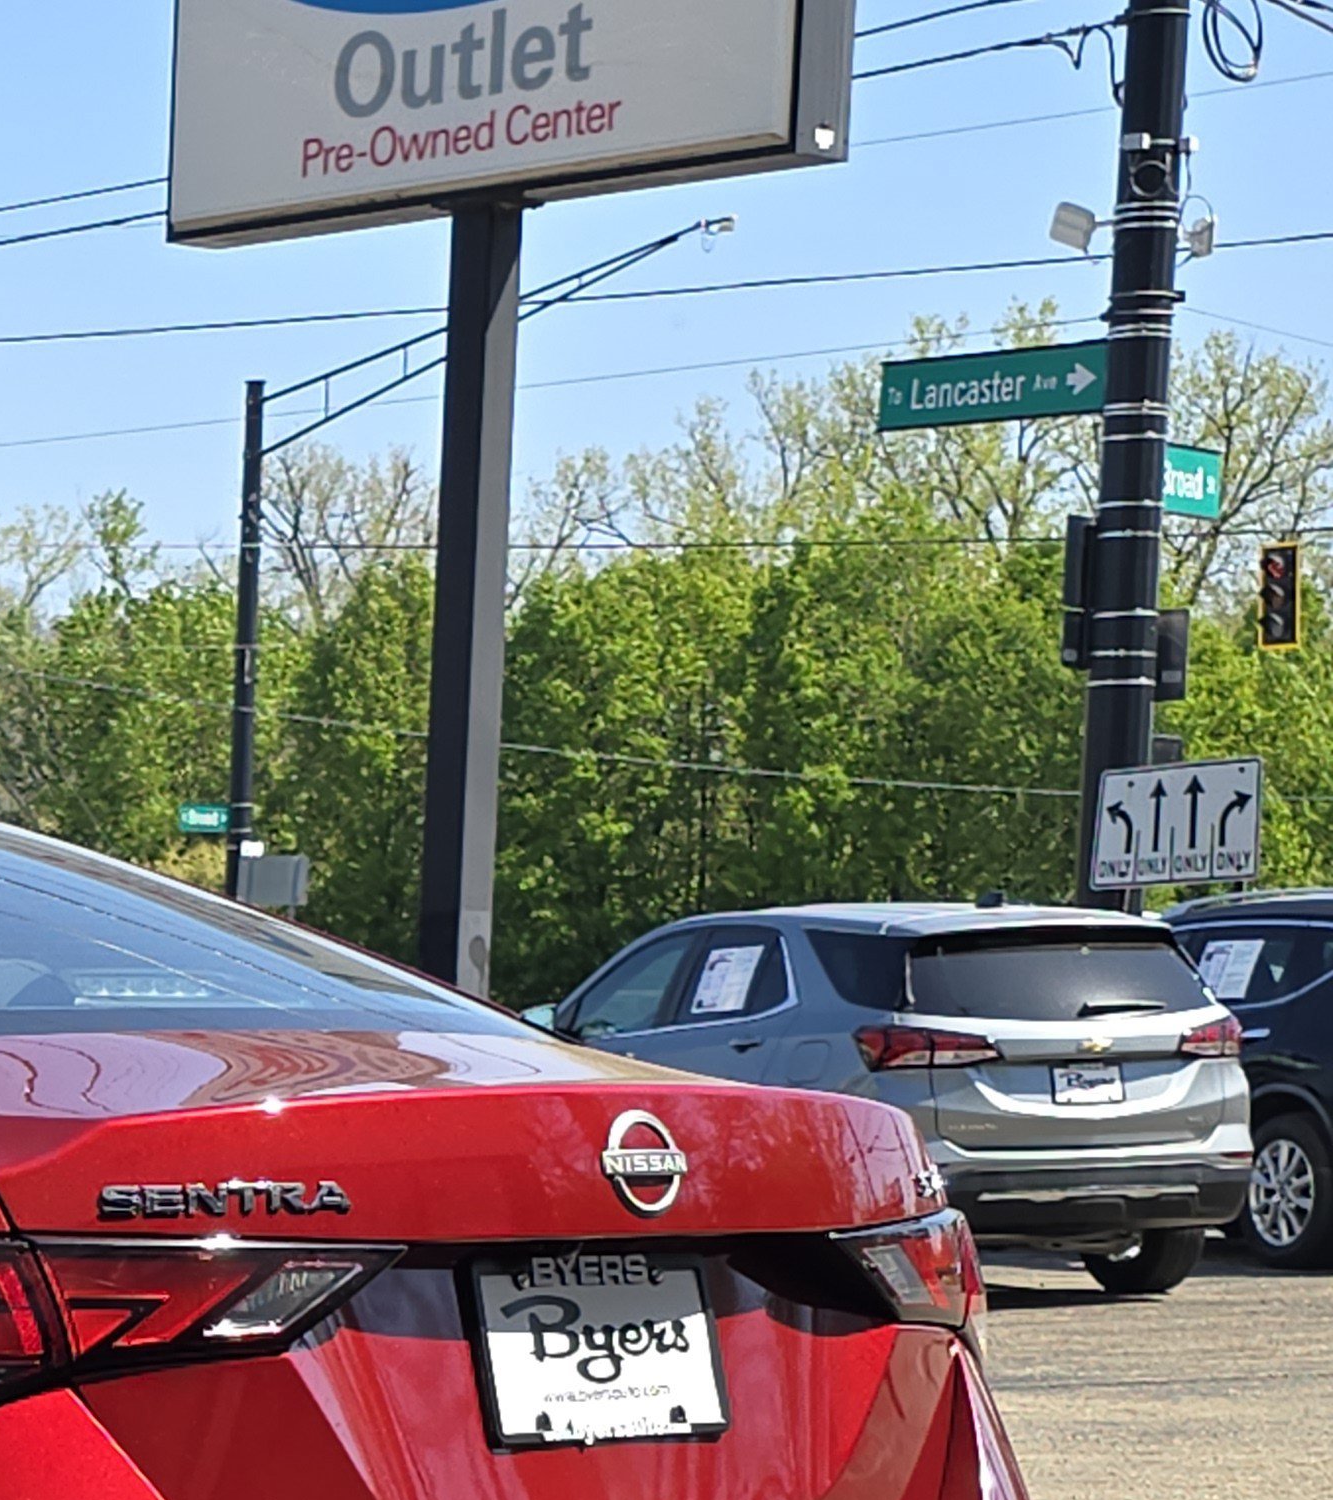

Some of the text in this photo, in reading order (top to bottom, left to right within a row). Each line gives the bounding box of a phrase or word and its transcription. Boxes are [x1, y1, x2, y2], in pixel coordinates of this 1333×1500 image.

[334, 3, 593, 118] Outlet
[302, 101, 622, 178] Pre-Owned Center
[887, 370, 1059, 411] To Lancaster Ave
[1097, 850, 1252, 879] ONLY ONLY ONLY ONLY
[603, 1151, 689, 1175] NISSAN
[98, 1178, 352, 1221] SENTRA
[532, 1254, 647, 1286] BYERS
[499, 1294, 691, 1384] Byers
